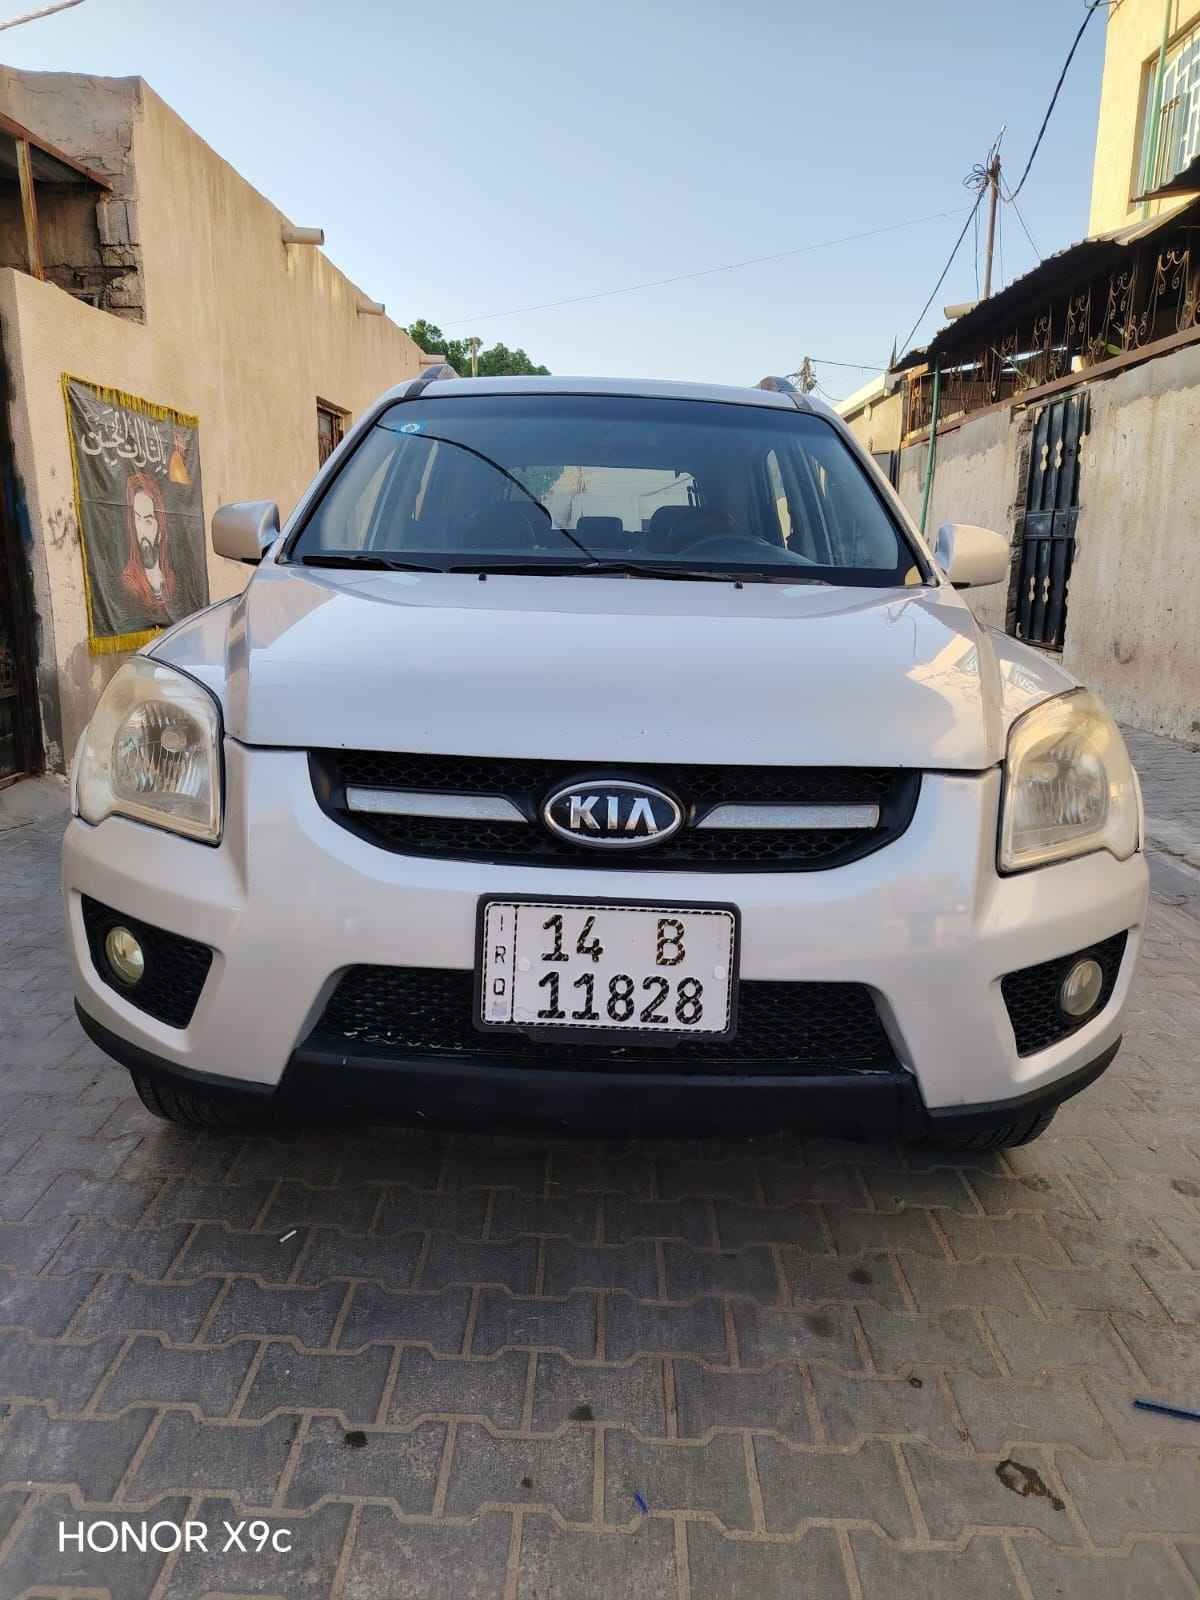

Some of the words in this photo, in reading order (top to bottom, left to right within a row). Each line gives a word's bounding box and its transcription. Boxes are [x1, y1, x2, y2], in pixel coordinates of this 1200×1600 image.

[568, 795, 660, 834] KIA
[541, 914, 604, 962] 14
[655, 918, 686, 966] B
[537, 971, 703, 1025] 11828
